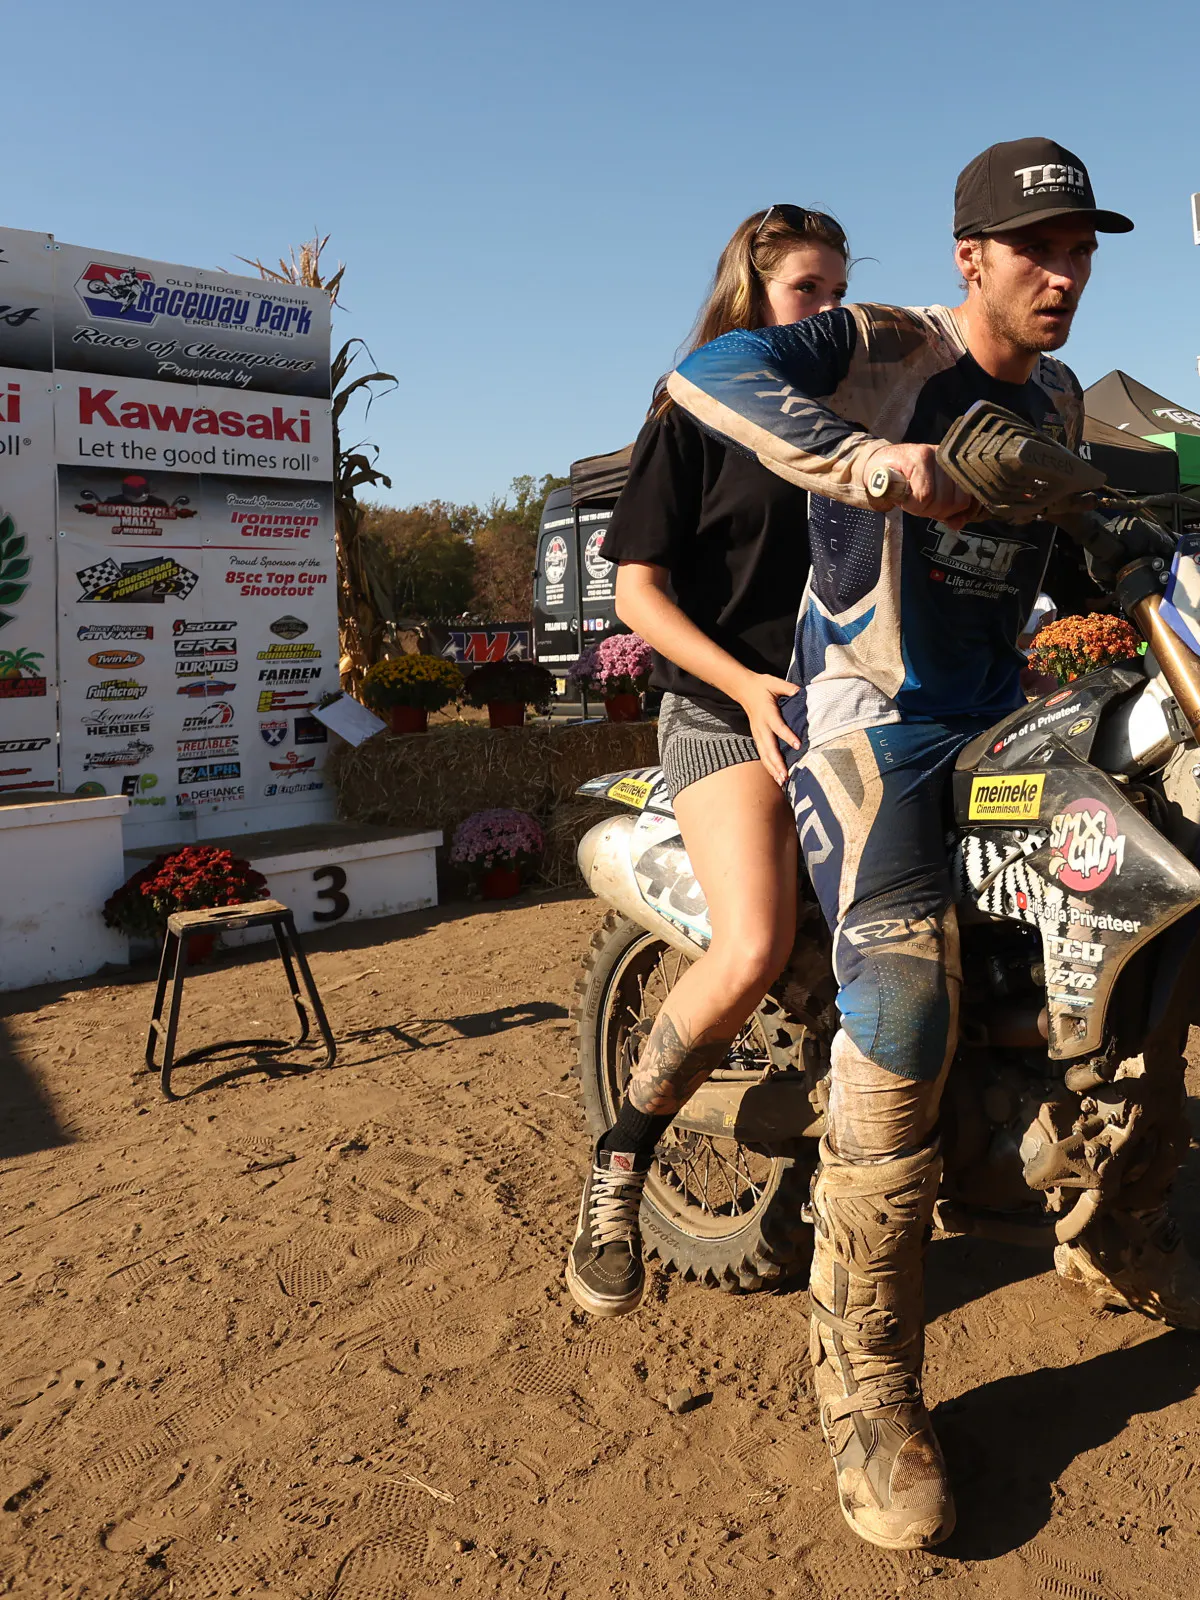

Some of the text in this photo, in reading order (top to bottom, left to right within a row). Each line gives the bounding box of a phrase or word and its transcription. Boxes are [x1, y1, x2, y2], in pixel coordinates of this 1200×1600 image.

[1023, 185, 1085, 197] RACING
[166, 279, 309, 305] OLD BRIDGE TOWNSHIP
[135, 280, 313, 335] Raceway Park
[73, 326, 316, 372] Race of Champions
[158, 362, 252, 388] Presented by
[79, 387, 311, 443] Kawasaki
[79, 438, 115, 458] Let
[121, 440, 157, 460] the
[163, 446, 216, 467] good
[223, 448, 276, 469] times
[227, 494, 320, 510] Proud Sponsor of the
[97, 504, 177, 518] MOTORCYCLE
[121, 517, 154, 527] MALL
[231, 512, 319, 526] Ironman
[241, 525, 311, 538] Classic
[229, 555, 320, 568] Proud Sponsor of the
[117, 561, 172, 588] CROSSROAD
[225, 571, 328, 586] 85cc Top Gun
[945, 574, 964, 587] Life
[112, 567, 178, 599] POWERSPORTS
[240, 585, 315, 596] Shootout
[184, 622, 236, 631] SCOTT
[176, 639, 235, 651] GRR
[268, 644, 315, 652] Factory
[441, 631, 532, 664] AMA
[97, 653, 139, 664] Twin Air
[257, 650, 322, 660] Connection
[258, 667, 322, 681] FARREN
[183, 717, 207, 727] DTM
[1002, 702, 1082, 748] Life of a Privateer
[87, 723, 150, 736] HEROES
[267, 729, 281, 743] X
[183, 739, 231, 752] RELIABLE
[196, 763, 240, 777] ALPHA
[191, 786, 245, 799] DEFIANCE
[614, 782, 648, 799] meineke
[974, 780, 1038, 804] meineke
[192, 795, 245, 805] LIFESTYLE
[976, 803, 1032, 814] Cinnaminson, NJ
[1050, 809, 1107, 848] SMX
[1067, 834, 1126, 877] CUM
[313, 866, 350, 922] 3
[1028, 897, 1141, 933] Life of a Privateer
[1049, 968, 1098, 990] FXR
